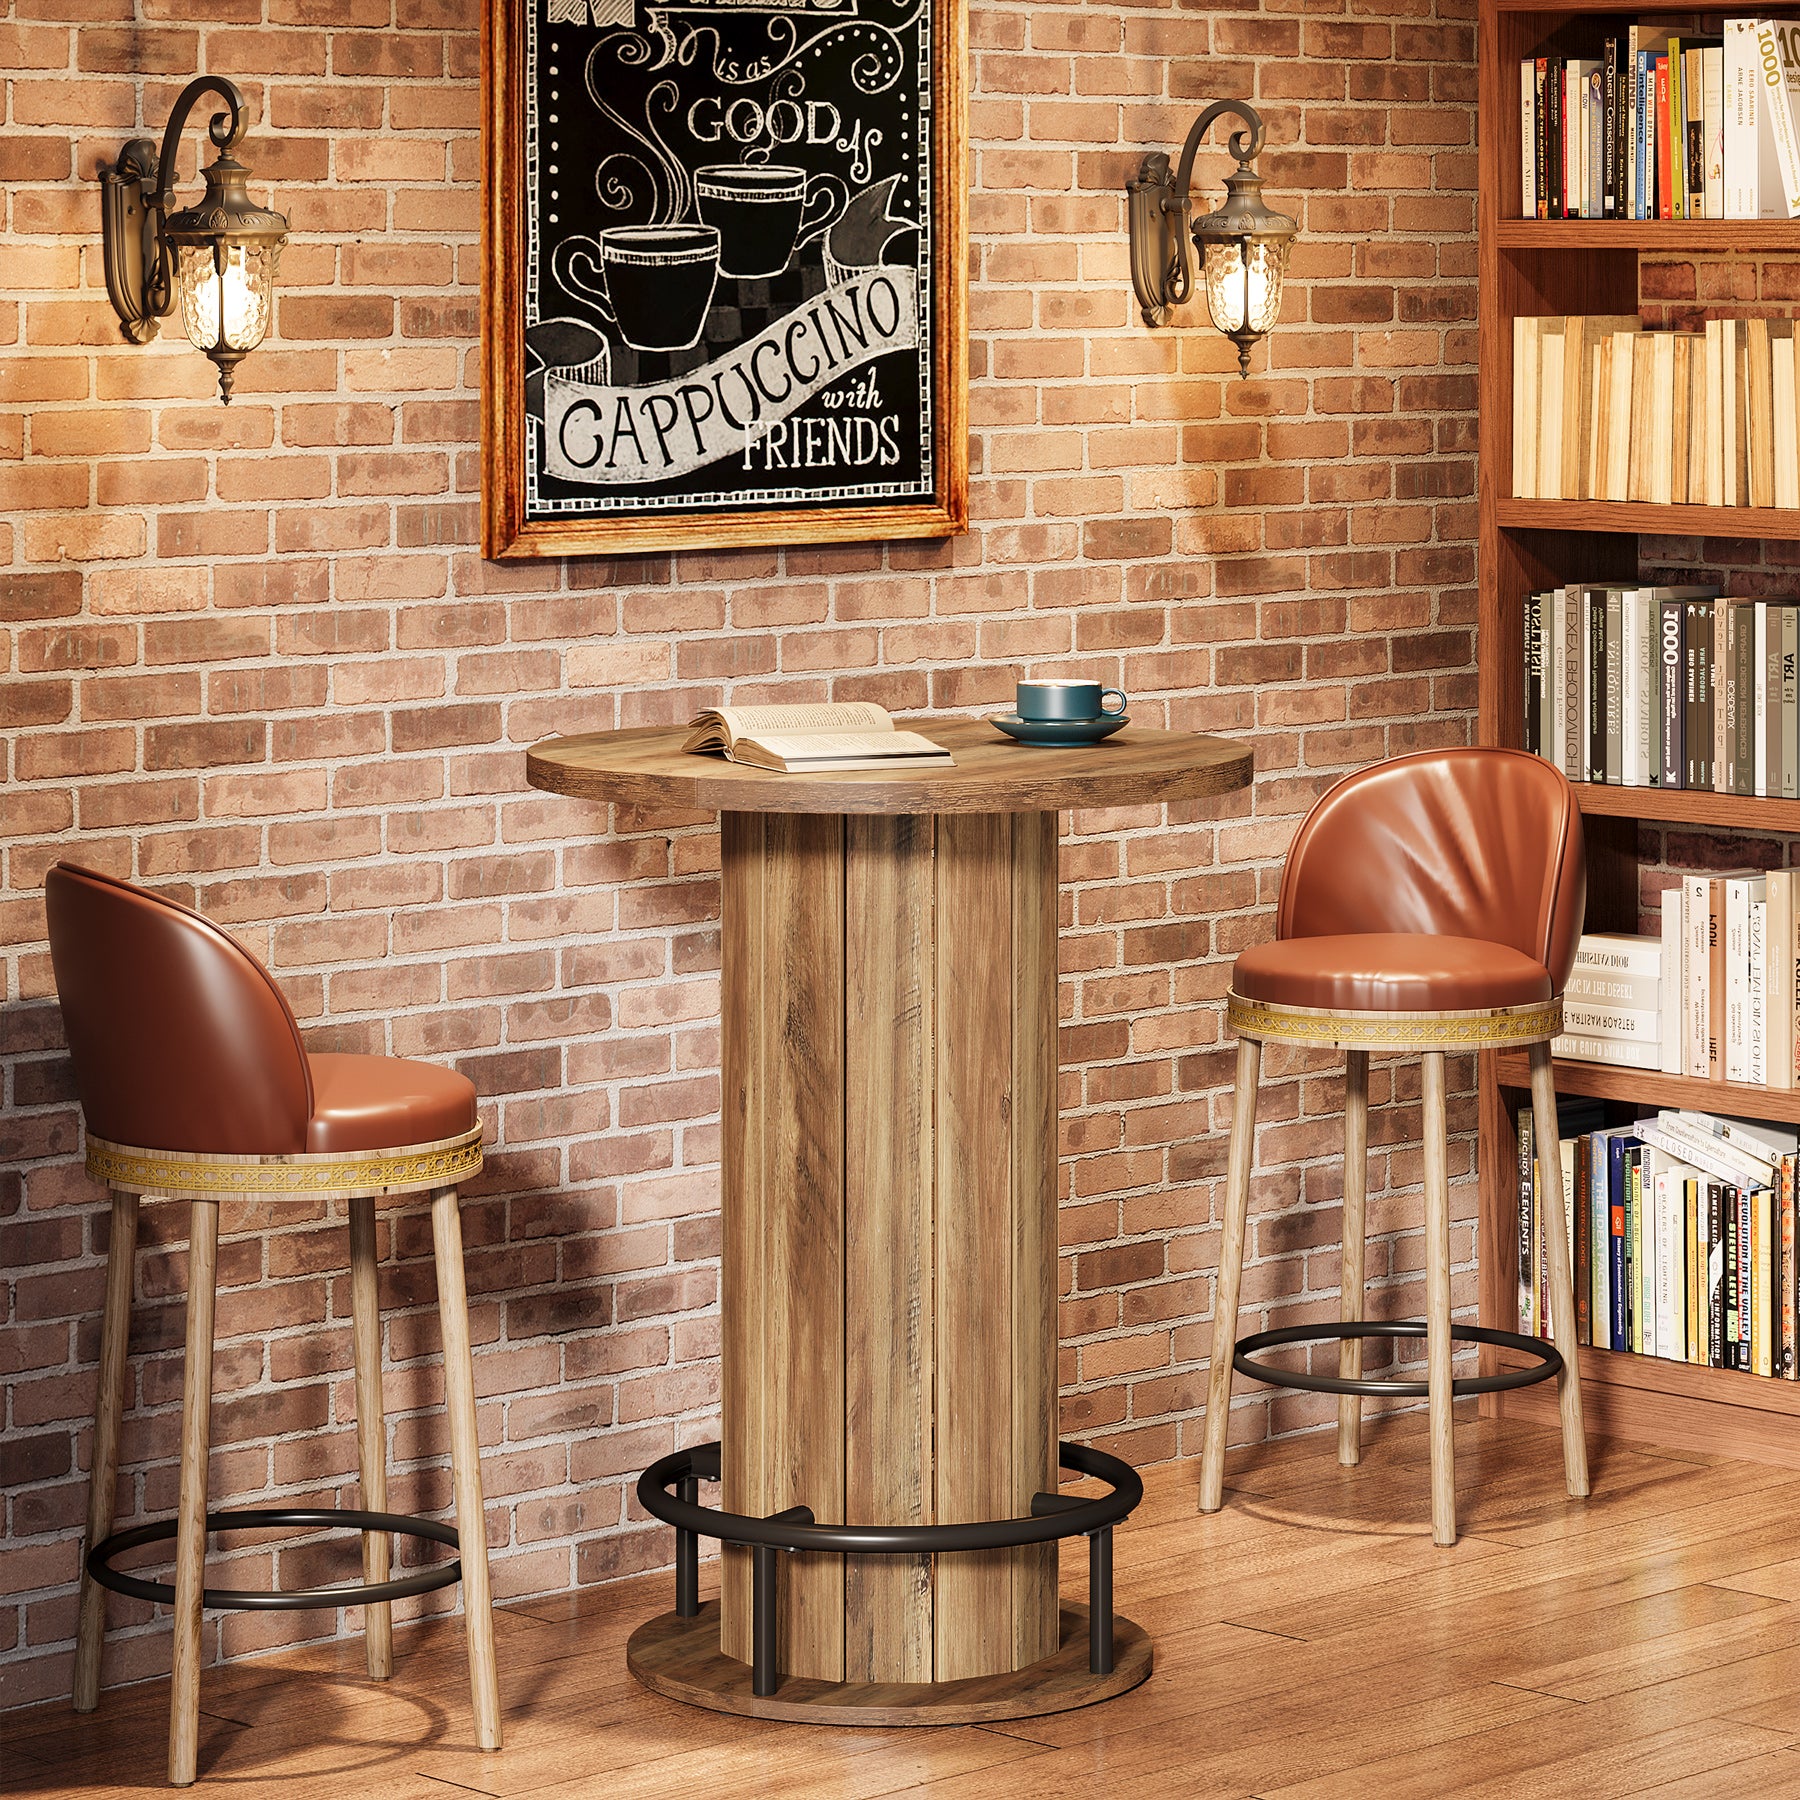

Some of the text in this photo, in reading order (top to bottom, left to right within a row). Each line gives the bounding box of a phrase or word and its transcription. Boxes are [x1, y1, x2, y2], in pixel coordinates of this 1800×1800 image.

[1606, 65, 1615, 98] Quest
[1638, 55, 1645, 72] on
[1758, 28, 1781, 87] 1000
[687, 97, 841, 143] GOOD
[1637, 73, 1646, 144] intelligence
[1606, 106, 1615, 185] Consciousness
[559, 276, 900, 468] CAPPUCCINO
[822, 366, 883, 410] with
[742, 414, 900, 470] FRIENDS
[1643, 1148, 1651, 1190] MICROCOSM
[1659, 1136, 1693, 1161] CLOSED
[1521, 1181, 1531, 1256] ELEMENTS
[1661, 1237, 1668, 1248] OF
[1596, 1178, 1606, 1323] THE IDEA FACTORY
[1728, 1222, 1737, 1270] STEVEN
[1741, 1194, 1749, 1337] REVOLUTION IN THE VALLEY
[1661, 1255, 1669, 1304] LIGHTNING
[1728, 1275, 1737, 1307] LEVY
[1727, 1309, 1739, 1342] HACKERS
